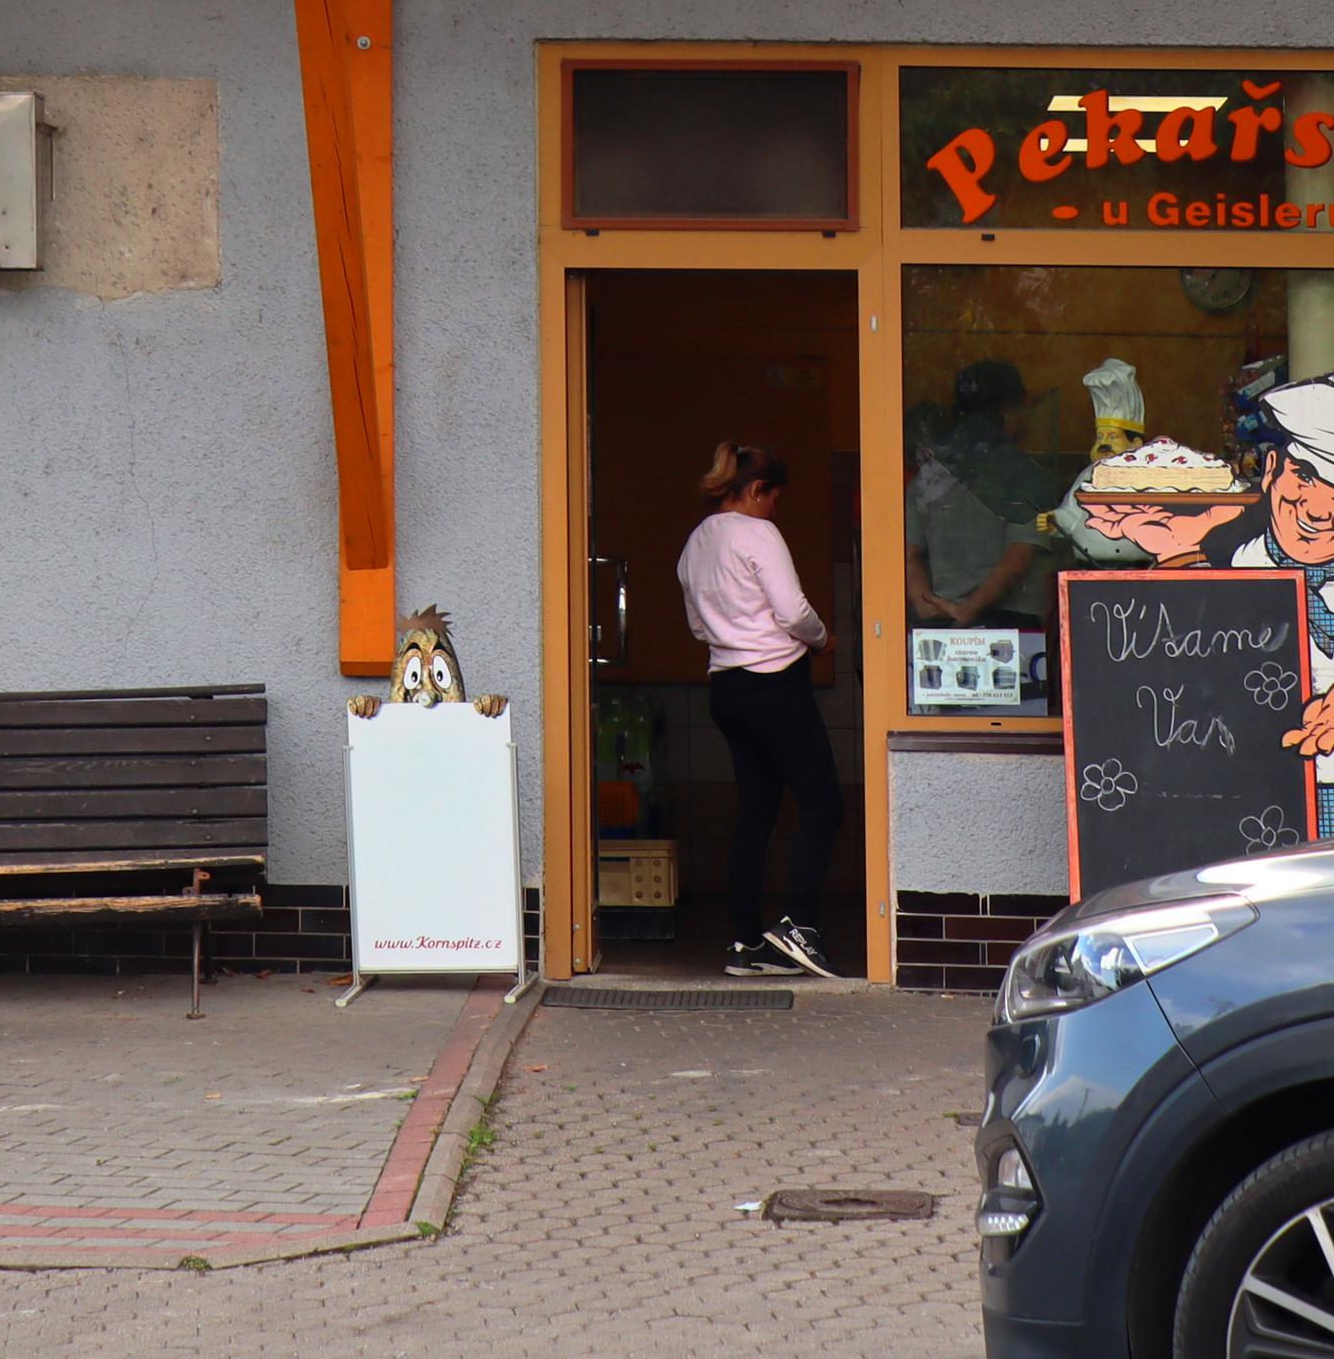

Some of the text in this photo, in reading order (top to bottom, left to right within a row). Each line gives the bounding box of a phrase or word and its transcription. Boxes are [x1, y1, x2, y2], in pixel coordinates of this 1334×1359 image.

[1103, 200, 1128, 227] u
[949, 636, 986, 646] KOUPÍM
[374, 935, 503, 951] www.Kornspitz.cz
[788, 928, 818, 956] REPLAY
